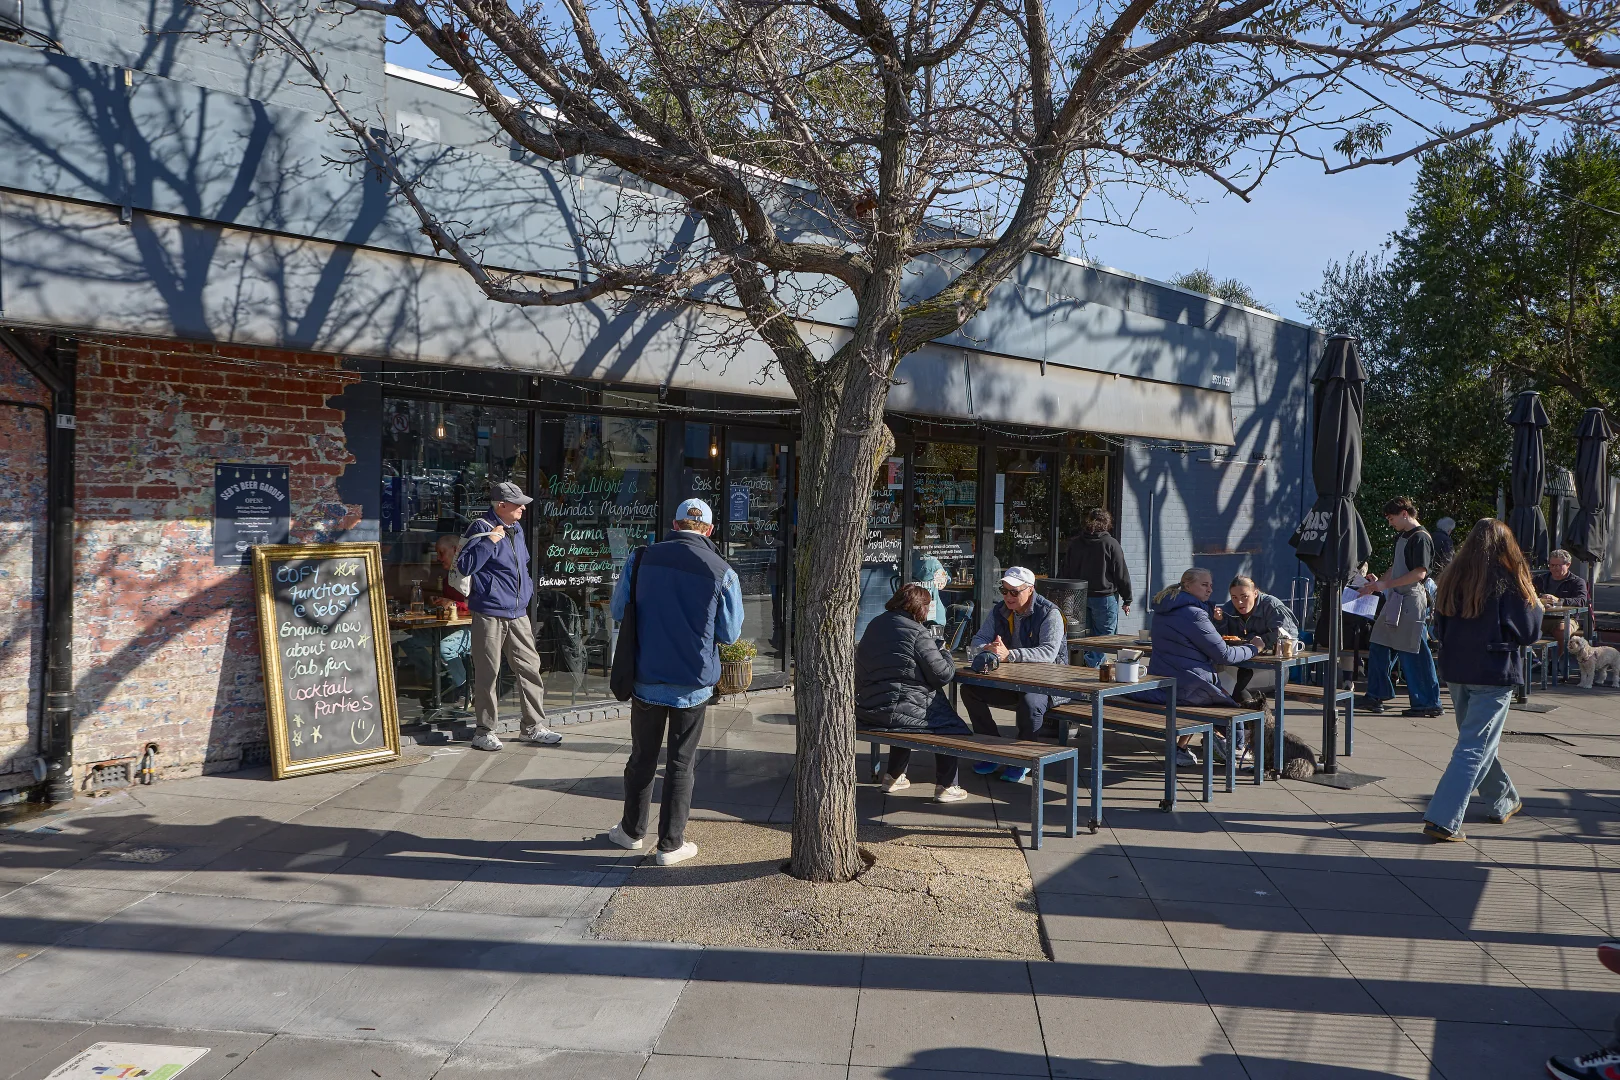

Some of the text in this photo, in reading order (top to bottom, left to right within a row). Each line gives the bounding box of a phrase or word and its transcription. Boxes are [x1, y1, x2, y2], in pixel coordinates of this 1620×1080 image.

[240, 481, 258, 490] BEER
[260, 482, 286, 502] GARDEN
[549, 474, 585, 502] Friday
[589, 476, 622, 500] Night
[562, 522, 604, 540] Parma
[294, 604, 308, 618] @
[280, 621, 362, 640] Enquire now
[286, 636, 355, 658] about our
